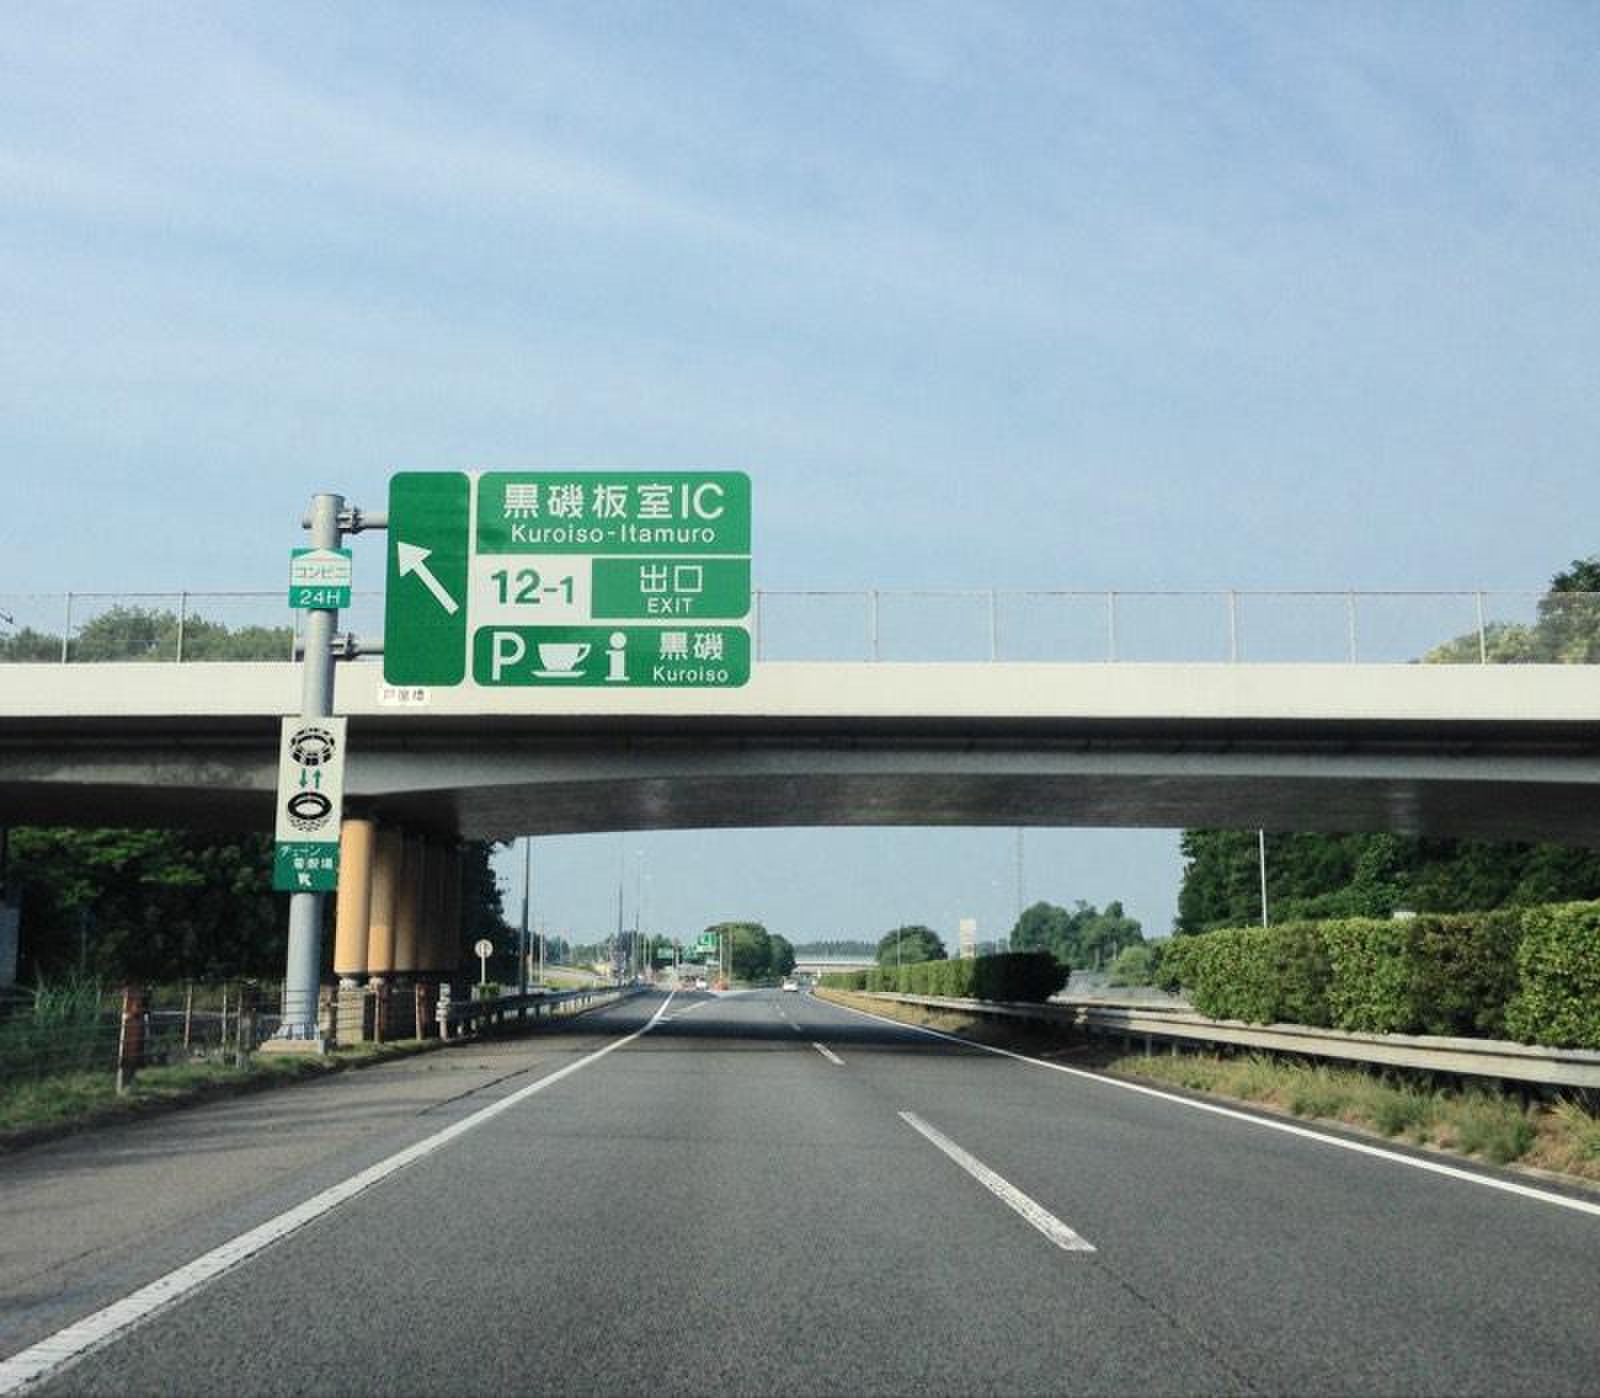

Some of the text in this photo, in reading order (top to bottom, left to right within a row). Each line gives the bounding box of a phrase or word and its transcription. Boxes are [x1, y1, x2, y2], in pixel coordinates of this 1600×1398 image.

[504, 484, 724, 519] 黒磯板室IC
[511, 524, 715, 543] Kuroiso-Itamuro
[491, 569, 574, 604] 12-1
[640, 565, 703, 592] 出口
[300, 589, 340, 605] 24H
[648, 598, 693, 613] EXIT
[492, 632, 526, 681] P
[660, 632, 723, 660] 黒磯
[653, 666, 729, 683] Kuroiso
